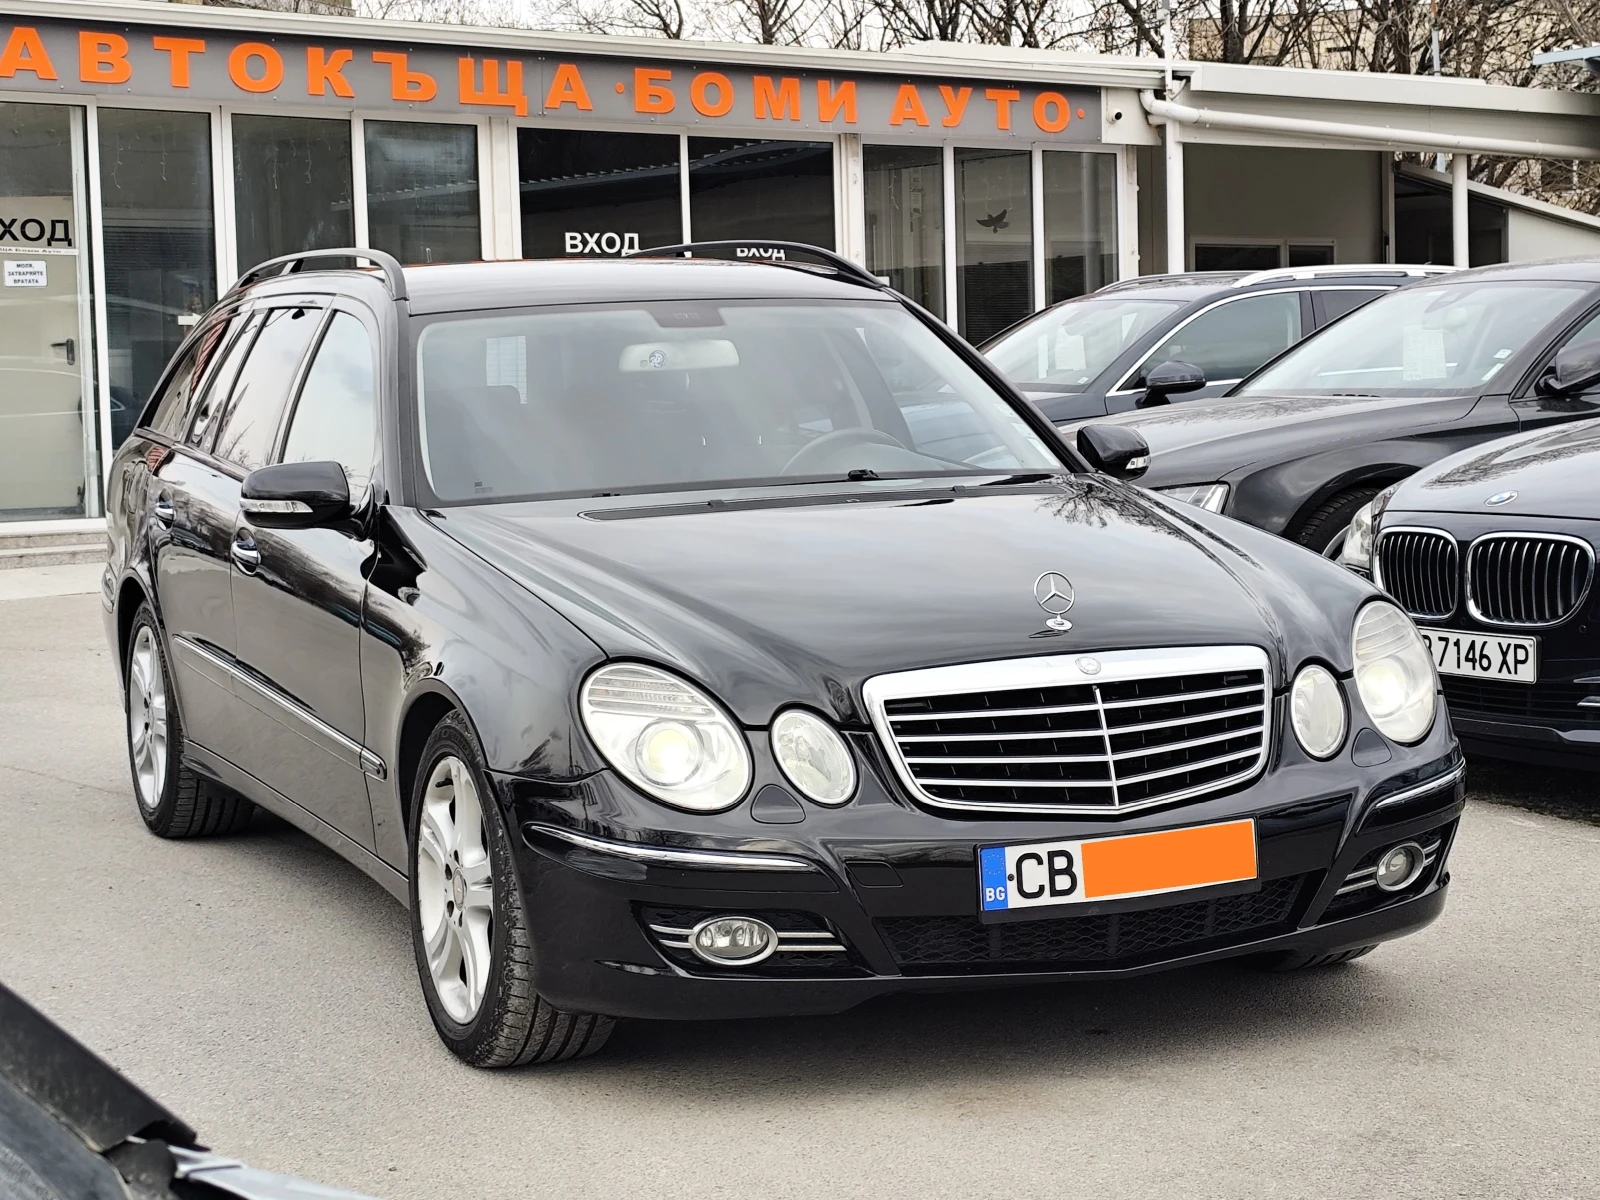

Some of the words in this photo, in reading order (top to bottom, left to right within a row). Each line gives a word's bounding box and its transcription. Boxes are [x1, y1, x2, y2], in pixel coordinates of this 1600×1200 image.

[0, 26, 593, 117] АВТОКЪЩА
[565, 232, 640, 257] ВХОД
[1438, 636, 1492, 672] 7146
[1497, 641, 1529, 675] XP
[1015, 849, 1078, 899] CB
[985, 886, 1006, 902] BG
